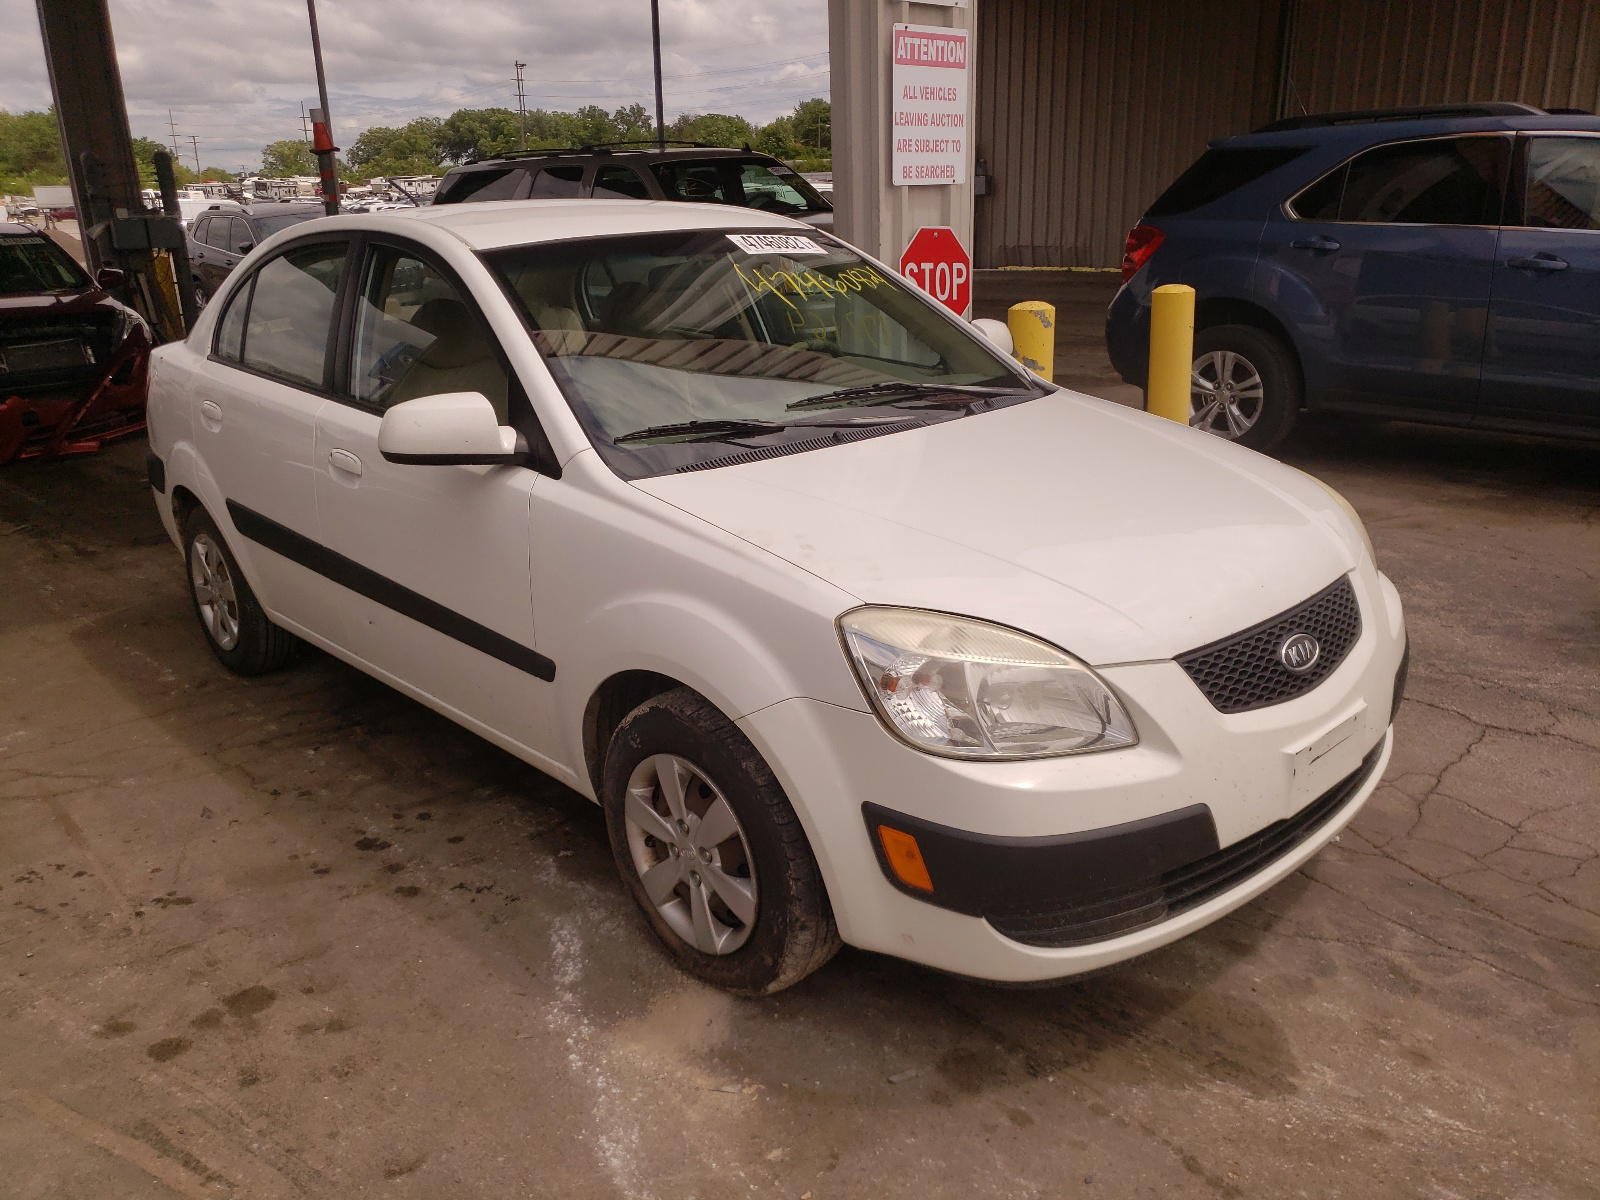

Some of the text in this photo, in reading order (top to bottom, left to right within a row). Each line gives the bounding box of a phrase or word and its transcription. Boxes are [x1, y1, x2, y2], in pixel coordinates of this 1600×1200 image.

[897, 36, 965, 64] ATTENTION
[902, 85, 957, 101] ALL VEHICLES
[894, 111, 964, 127] LEAVING AUCTION
[896, 138, 961, 153] ARE SUBJECT TO
[902, 164, 956, 179] BE SEARCHED
[740, 235, 812, 250] 47460821
[904, 261, 968, 301] STOP
[1287, 639, 1315, 667] KIA
